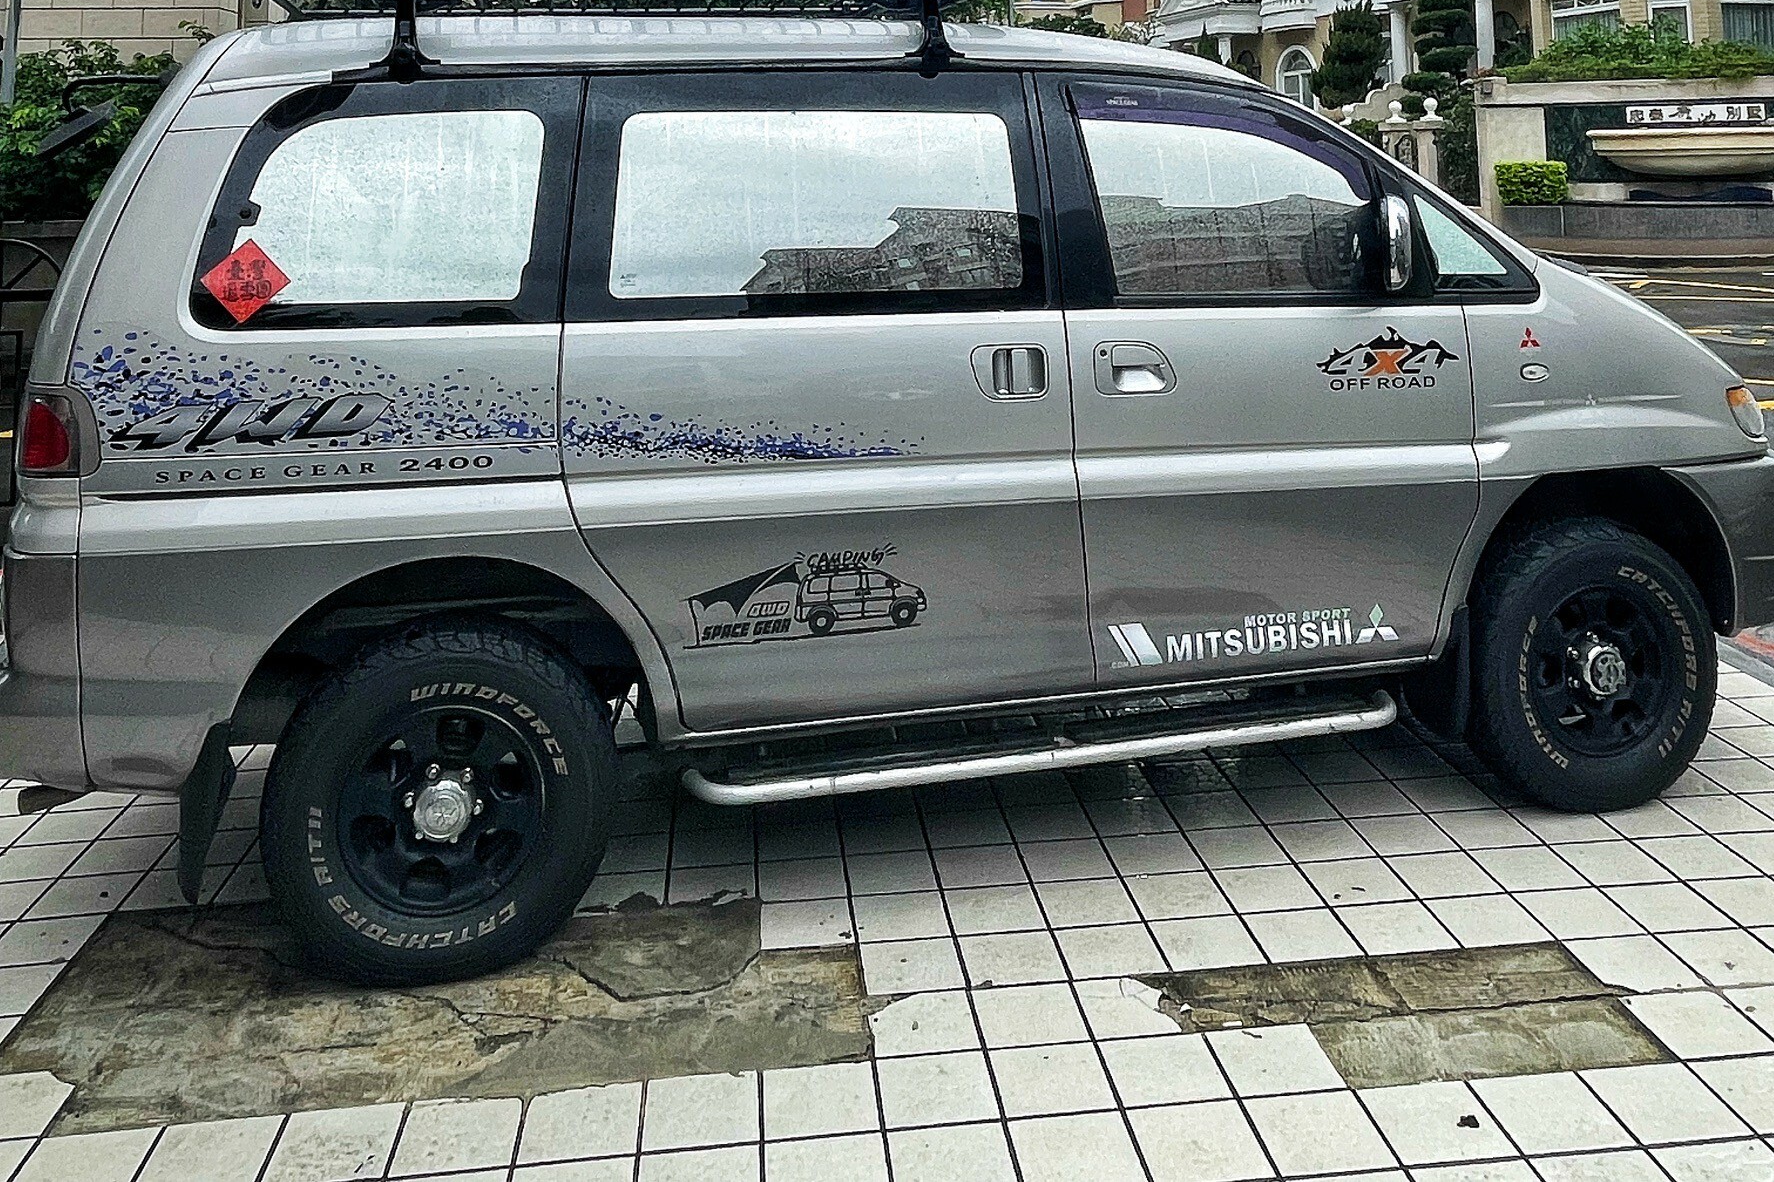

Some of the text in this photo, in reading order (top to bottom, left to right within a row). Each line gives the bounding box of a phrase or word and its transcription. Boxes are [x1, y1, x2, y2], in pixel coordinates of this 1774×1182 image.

[1329, 375, 1436, 391] OFF ROAD
[109, 392, 394, 451] 4WD
[155, 455, 494, 484] SPACE GEAR 2400
[806, 549, 885, 567] CAMPING
[702, 618, 792, 641] SPACE GEAR
[1244, 607, 1351, 629] MOTOR SPORT
[1166, 619, 1353, 663] MITSUBISHI
[410, 682, 569, 776] WINDFORCE
[328, 895, 518, 950] CATCHFORS
